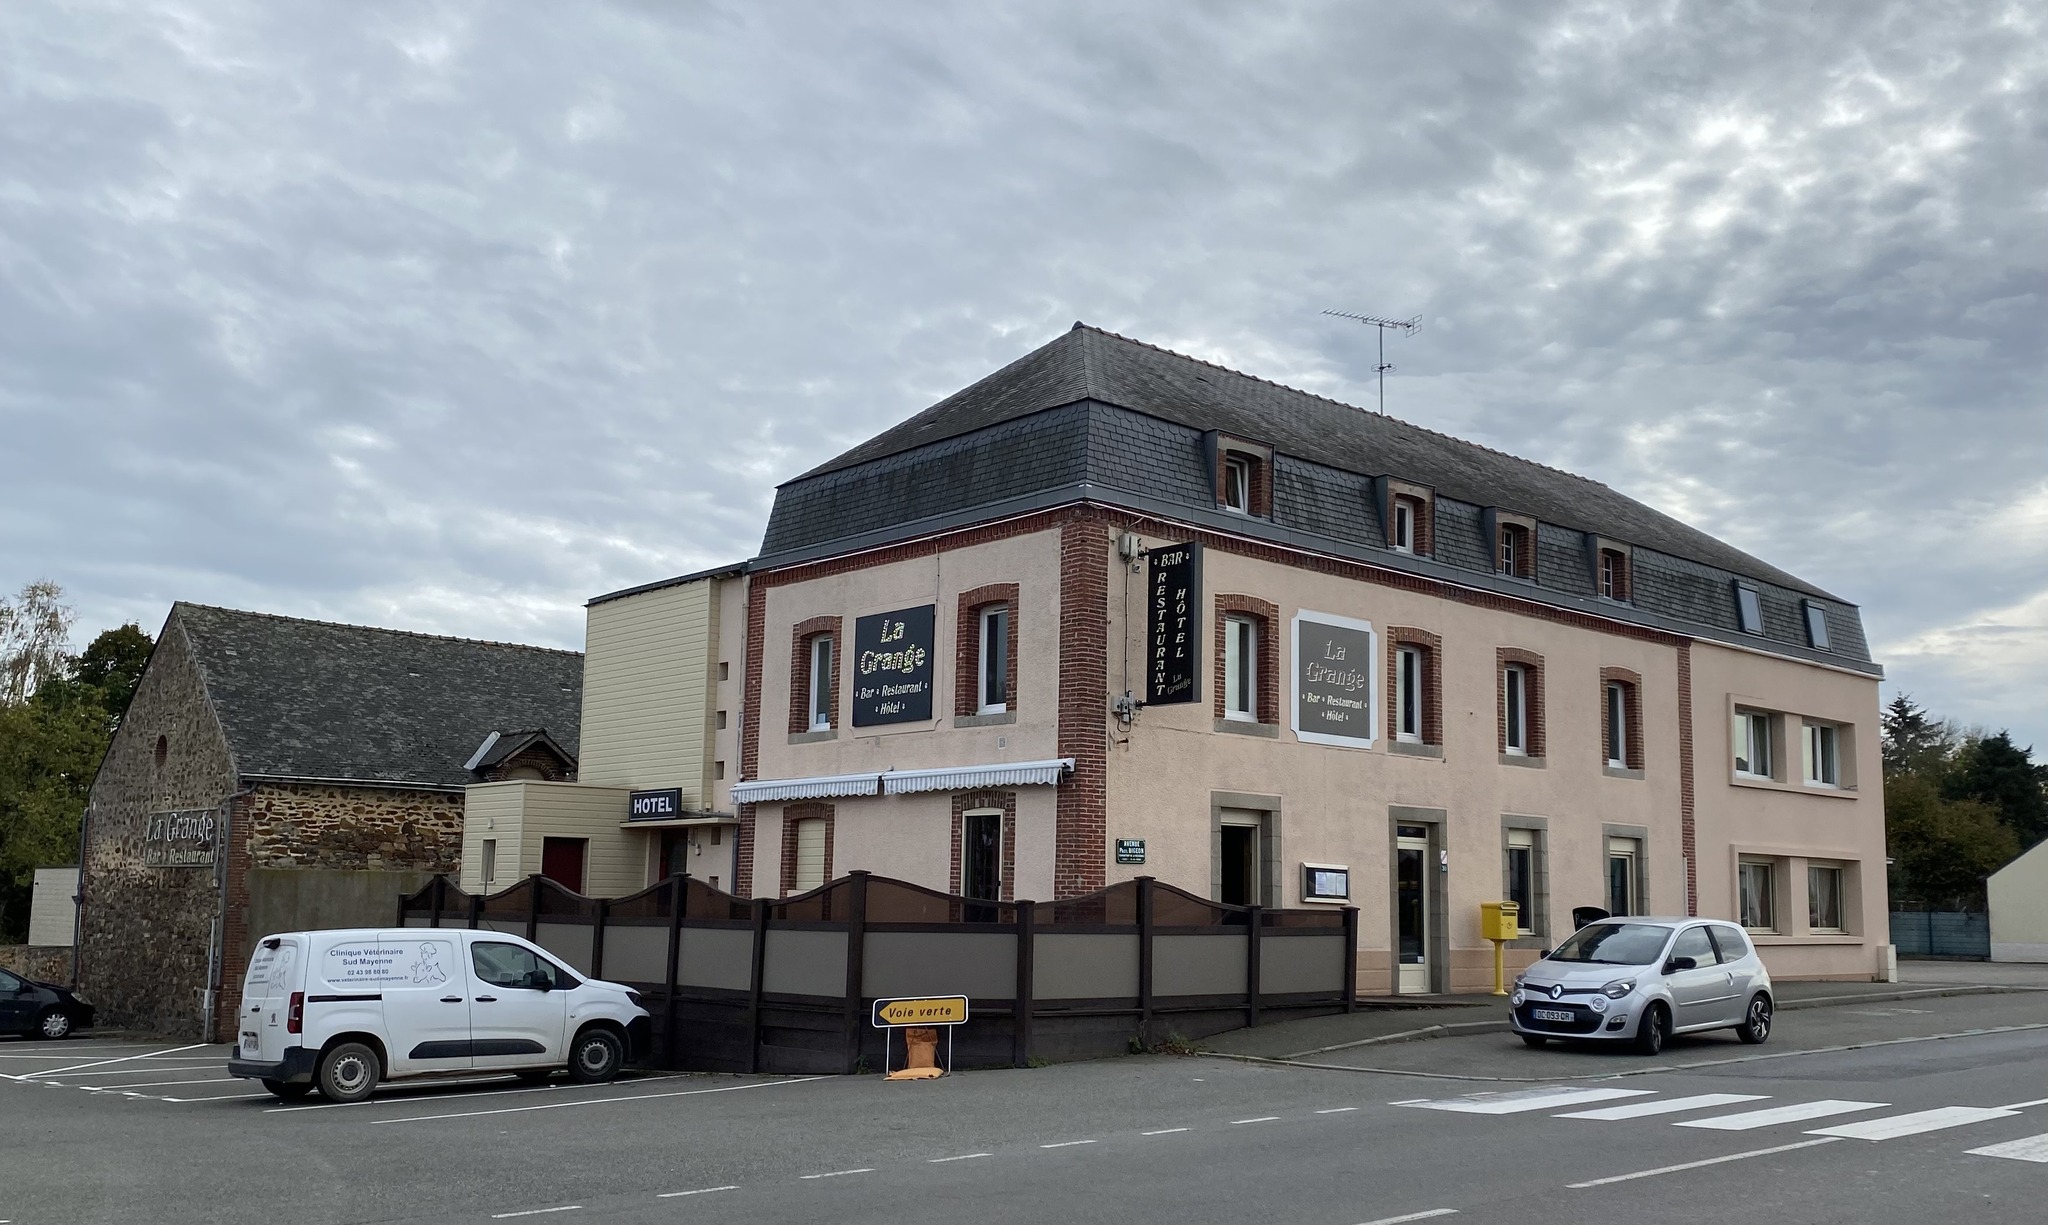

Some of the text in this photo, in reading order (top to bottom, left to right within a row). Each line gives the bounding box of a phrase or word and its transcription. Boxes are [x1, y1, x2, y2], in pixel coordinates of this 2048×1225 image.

[1161, 551, 1183, 567] BAR
[880, 619, 905, 643] La
[1175, 588, 1187, 658] HÔTEL
[1155, 572, 1167, 696] RESTAURANT
[860, 643, 926, 675] Grange
[1323, 640, 1346, 660] La
[1306, 662, 1365, 692] Grange
[860, 680, 923, 700] Bar Restaurant
[880, 701, 901, 715] Hôtel
[1307, 692, 1363, 710] Bar Restaurant
[1326, 710, 1344, 722] Hôtel
[634, 797, 673, 814] HOTEL
[146, 811, 214, 846] La Grange
[147, 847, 215, 864] Bar Restaurant
[330, 948, 404, 957] Clinique Vétérinaire
[342, 958, 393, 967] Sud Mayenne
[889, 1006, 952, 1018] Voie verte
